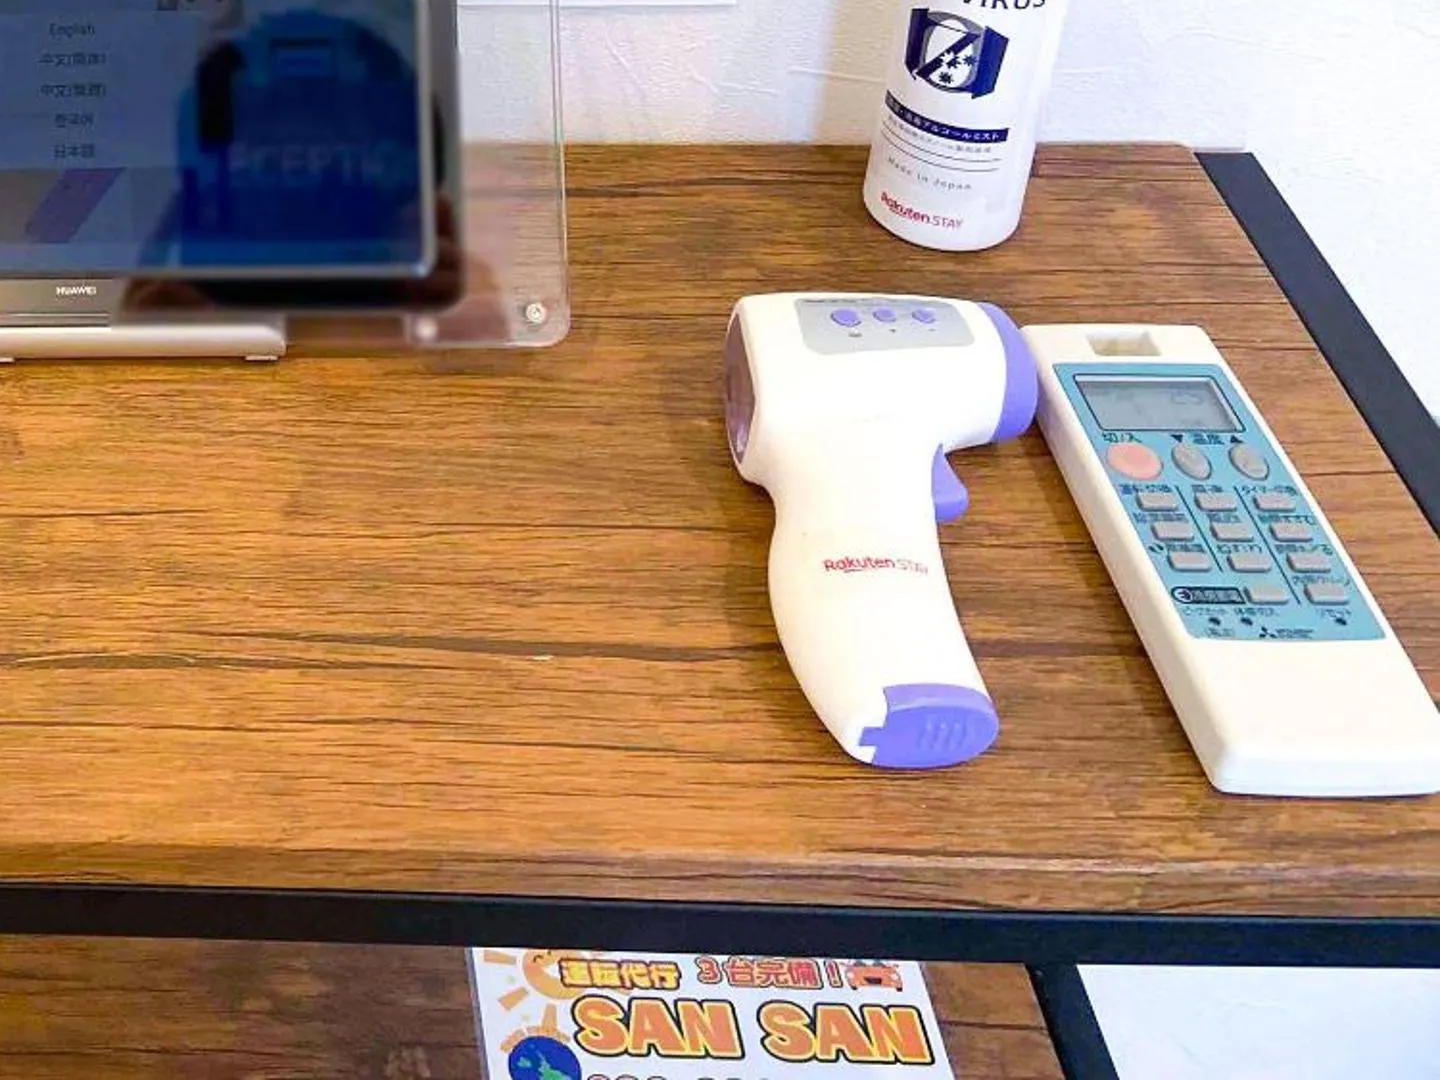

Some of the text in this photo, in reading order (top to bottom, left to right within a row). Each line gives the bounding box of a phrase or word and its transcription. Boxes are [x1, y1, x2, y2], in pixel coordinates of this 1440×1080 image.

[48, 22, 96, 40] English
[932, 177, 972, 191] Japan
[880, 190, 965, 230] Rakuten STAY
[55, 286, 97, 296] HUAWEI
[823, 555, 896, 574] Rakuten
[571, 993, 936, 1066] SAN SAN
